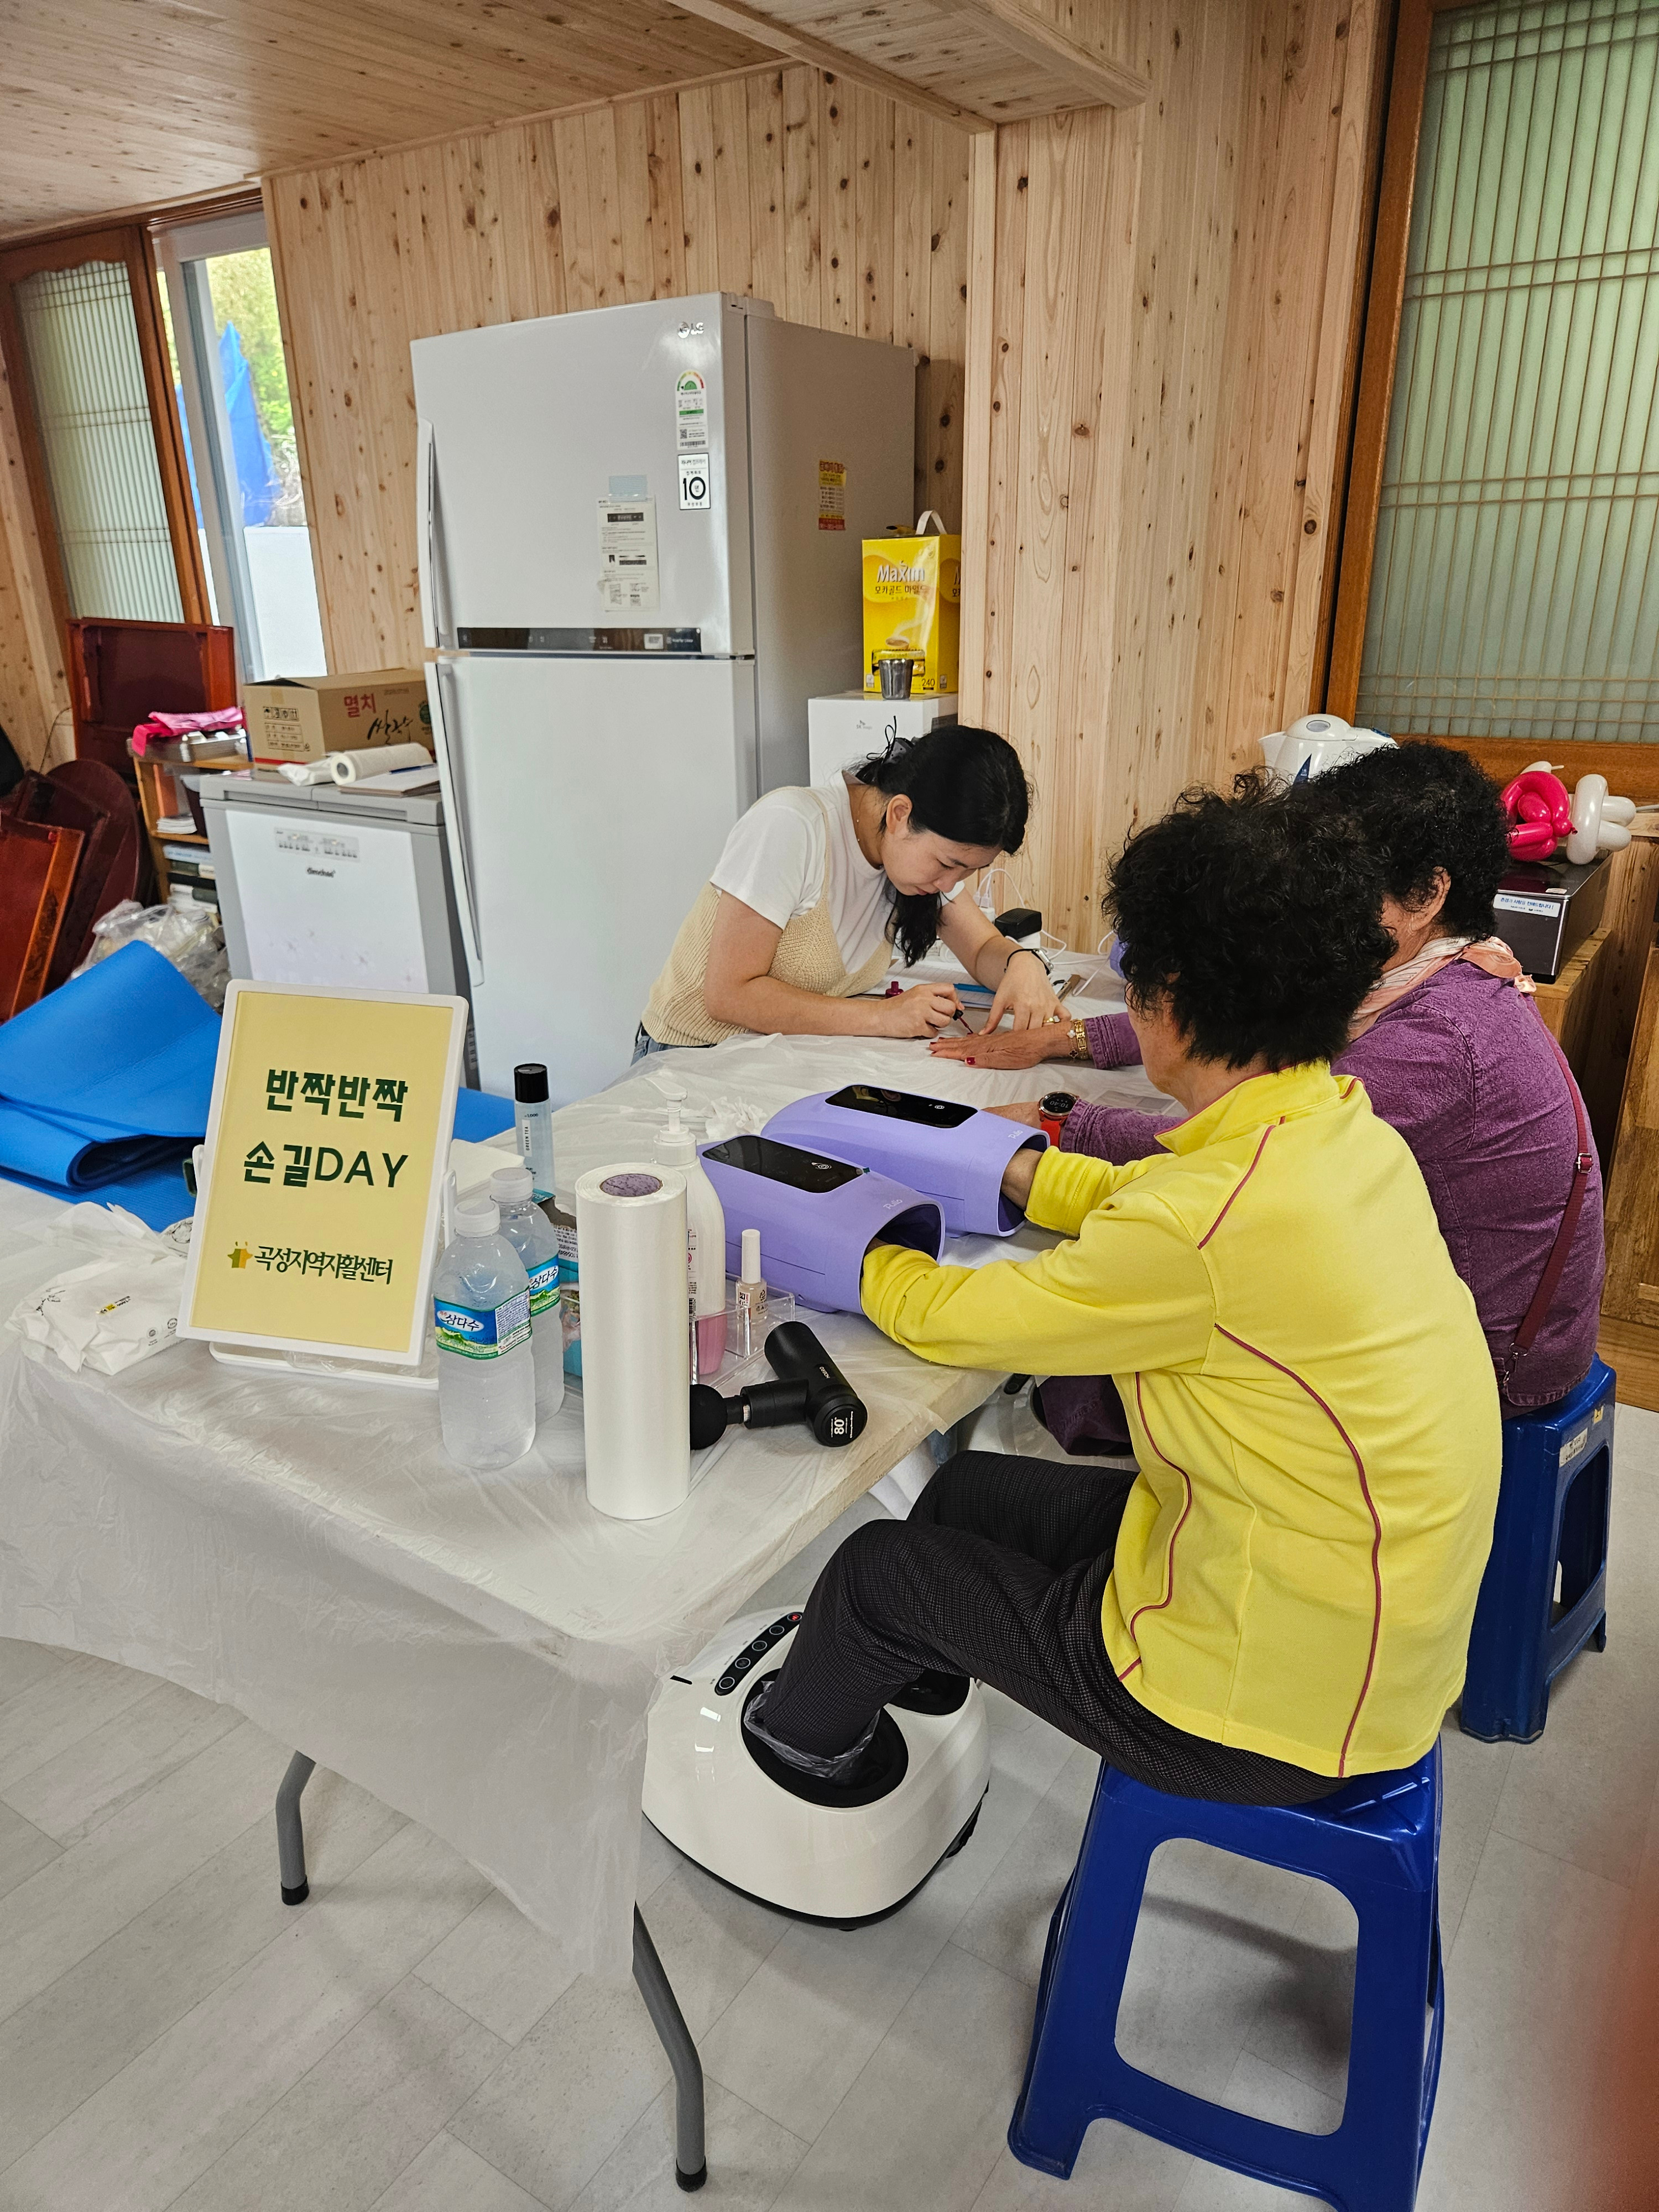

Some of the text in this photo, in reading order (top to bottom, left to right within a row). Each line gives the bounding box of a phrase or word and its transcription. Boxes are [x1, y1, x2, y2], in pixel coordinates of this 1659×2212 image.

[690, 322, 704, 335] LG
[682, 477, 706, 500] 10
[877, 561, 925, 583] Maxim
[875, 585, 902, 595] 모카골드
[922, 679, 935, 687] 240
[344, 693, 377, 718] 멸치
[266, 1069, 408, 1122] 반짝반짝
[243, 1141, 409, 1188] 손길DAY
[254, 1246, 393, 1285] 곡성지역자활센터
[531, 1266, 557, 1290] 삼다수
[443, 1314, 480, 1331] 삼다수
